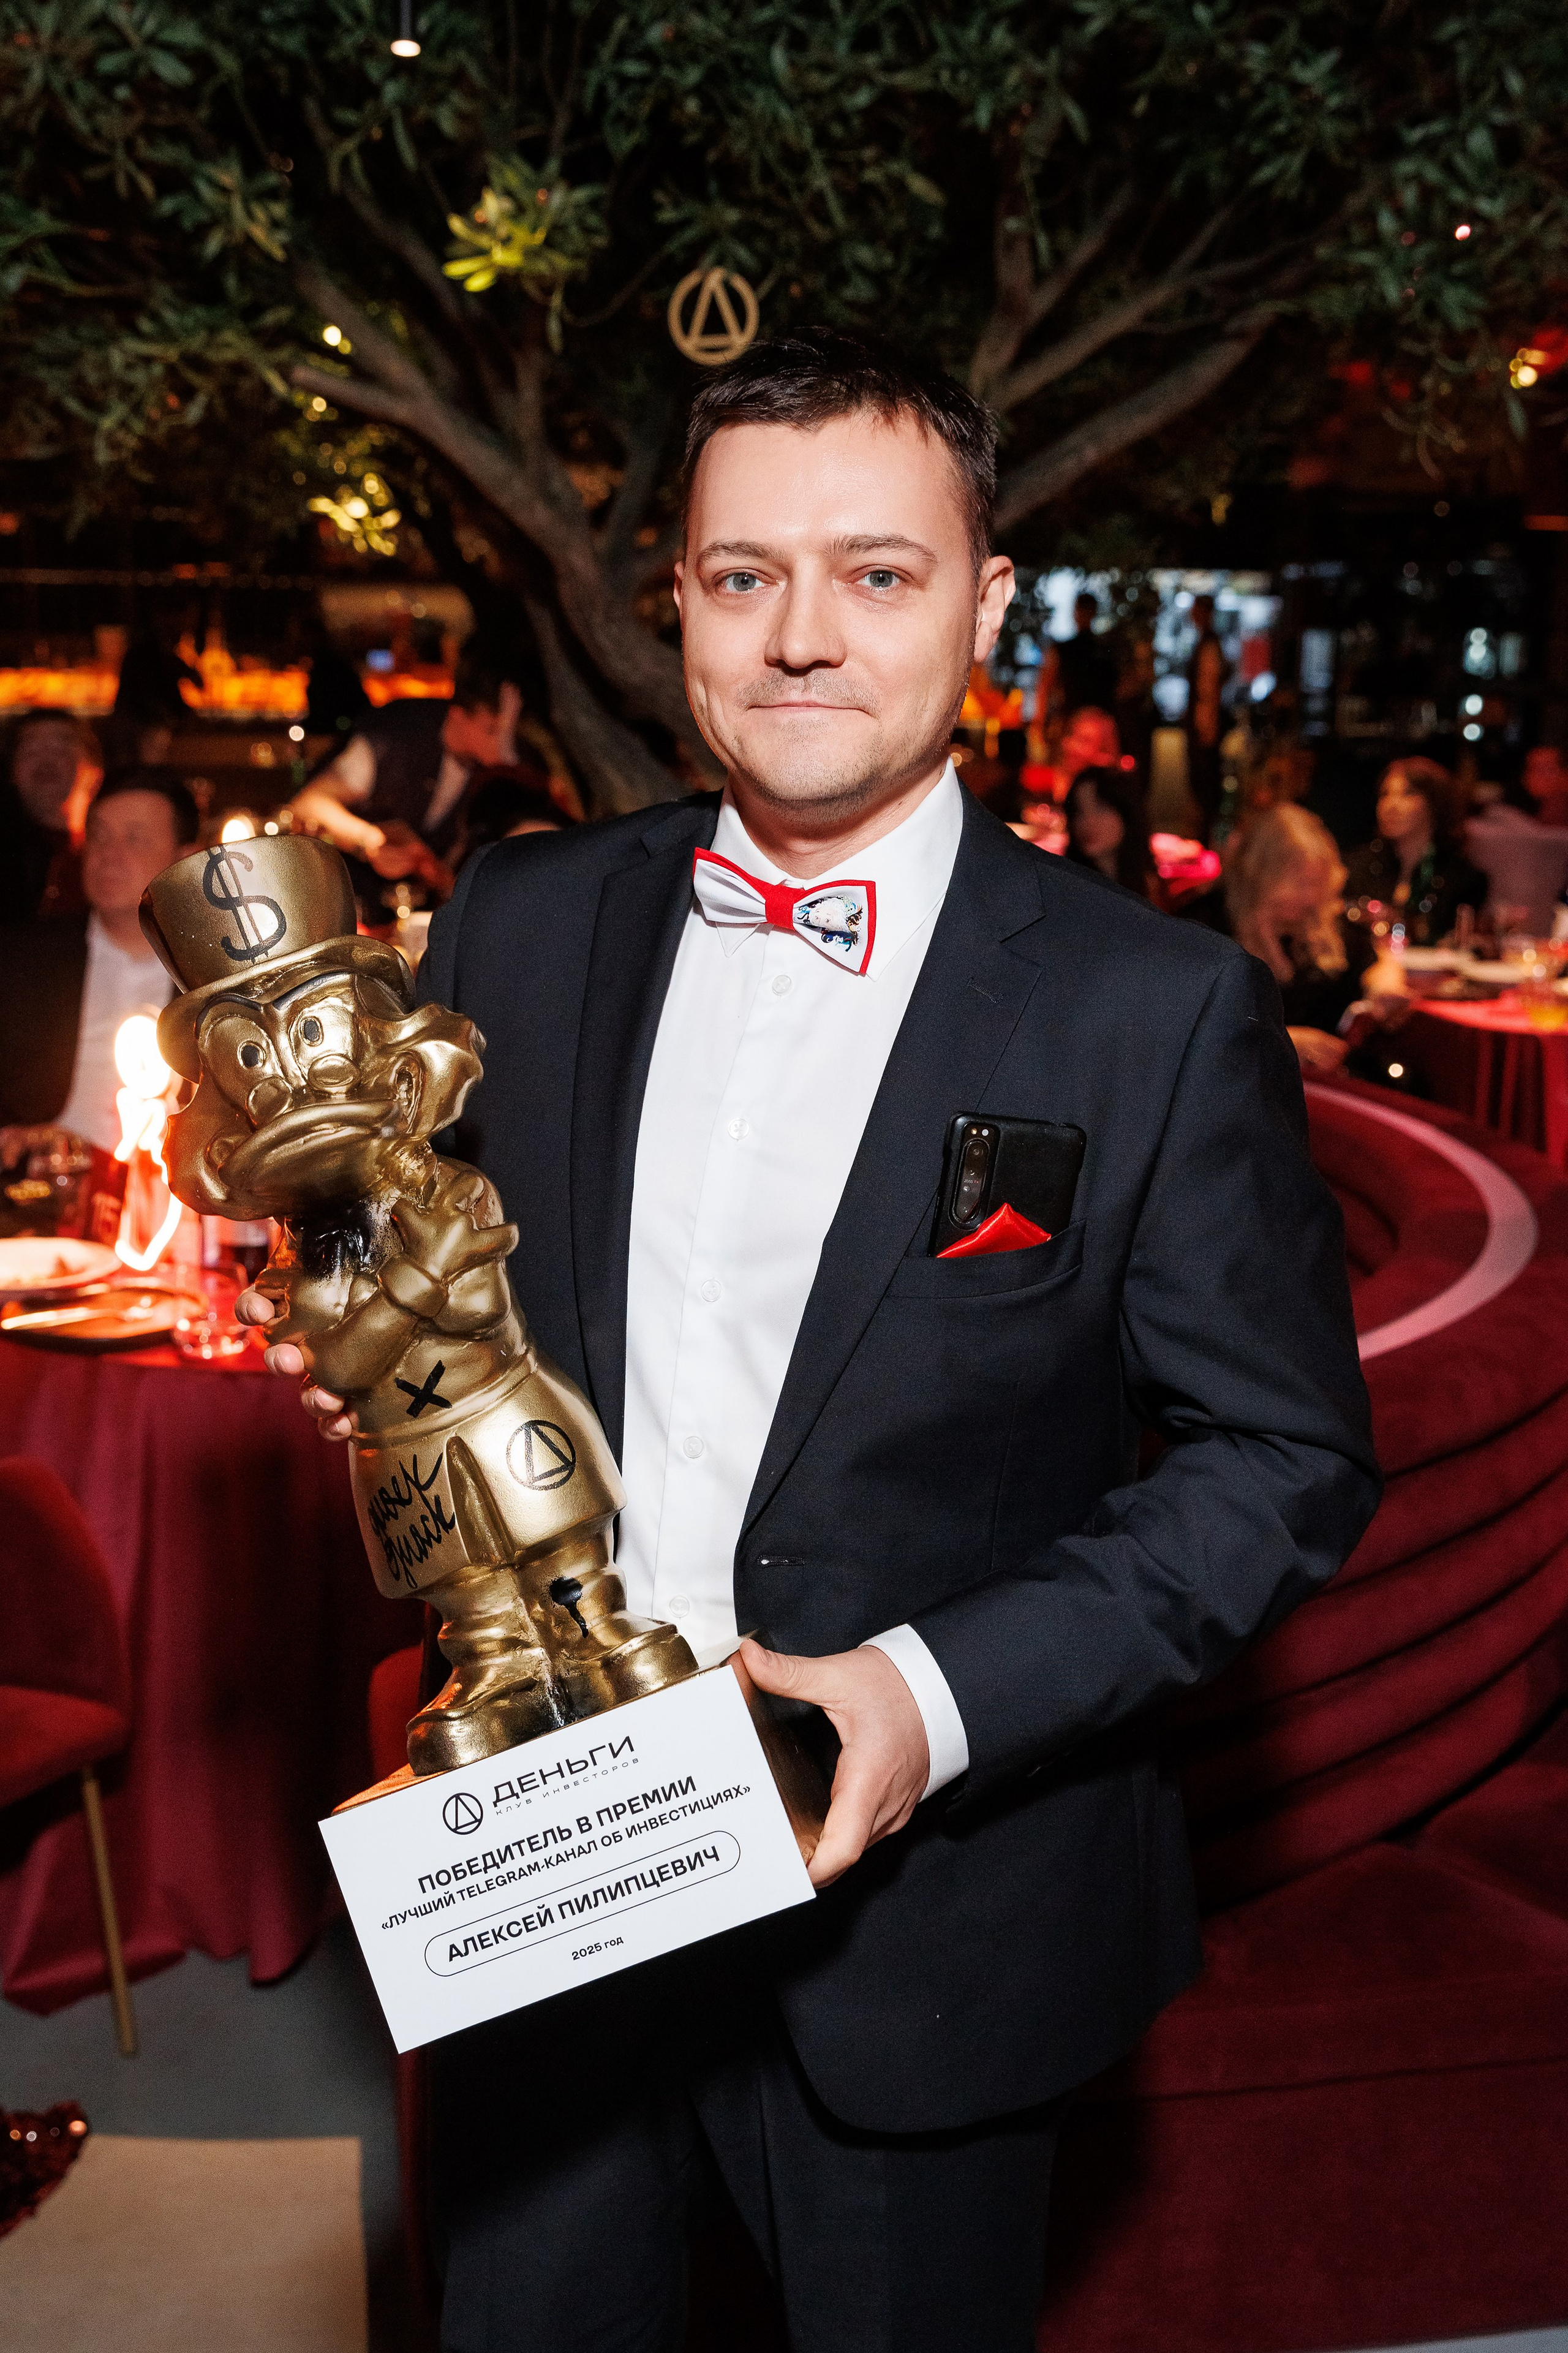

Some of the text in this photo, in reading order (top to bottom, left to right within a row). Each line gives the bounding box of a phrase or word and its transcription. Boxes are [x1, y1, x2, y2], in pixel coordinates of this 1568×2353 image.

[492, 1735, 635, 1808] ДЕНЬГИ
[496, 1758, 639, 1816] КЛУБ ИНВЕСТОРОВ
[381, 1785, 751, 1930] «ЛУЧШИЙ TELEGRAM-КАНАЛ ОБ ИНВЕСТИЦИЯХ»
[418, 1775, 697, 1894] ПОБЕДИТЕЛЬ В ПРЕМИИ
[448, 1845, 720, 1962] АЛЕКСЕЙ ПИЛИПЦЕВИЧ
[571, 1936, 624, 1961] 2025 год
